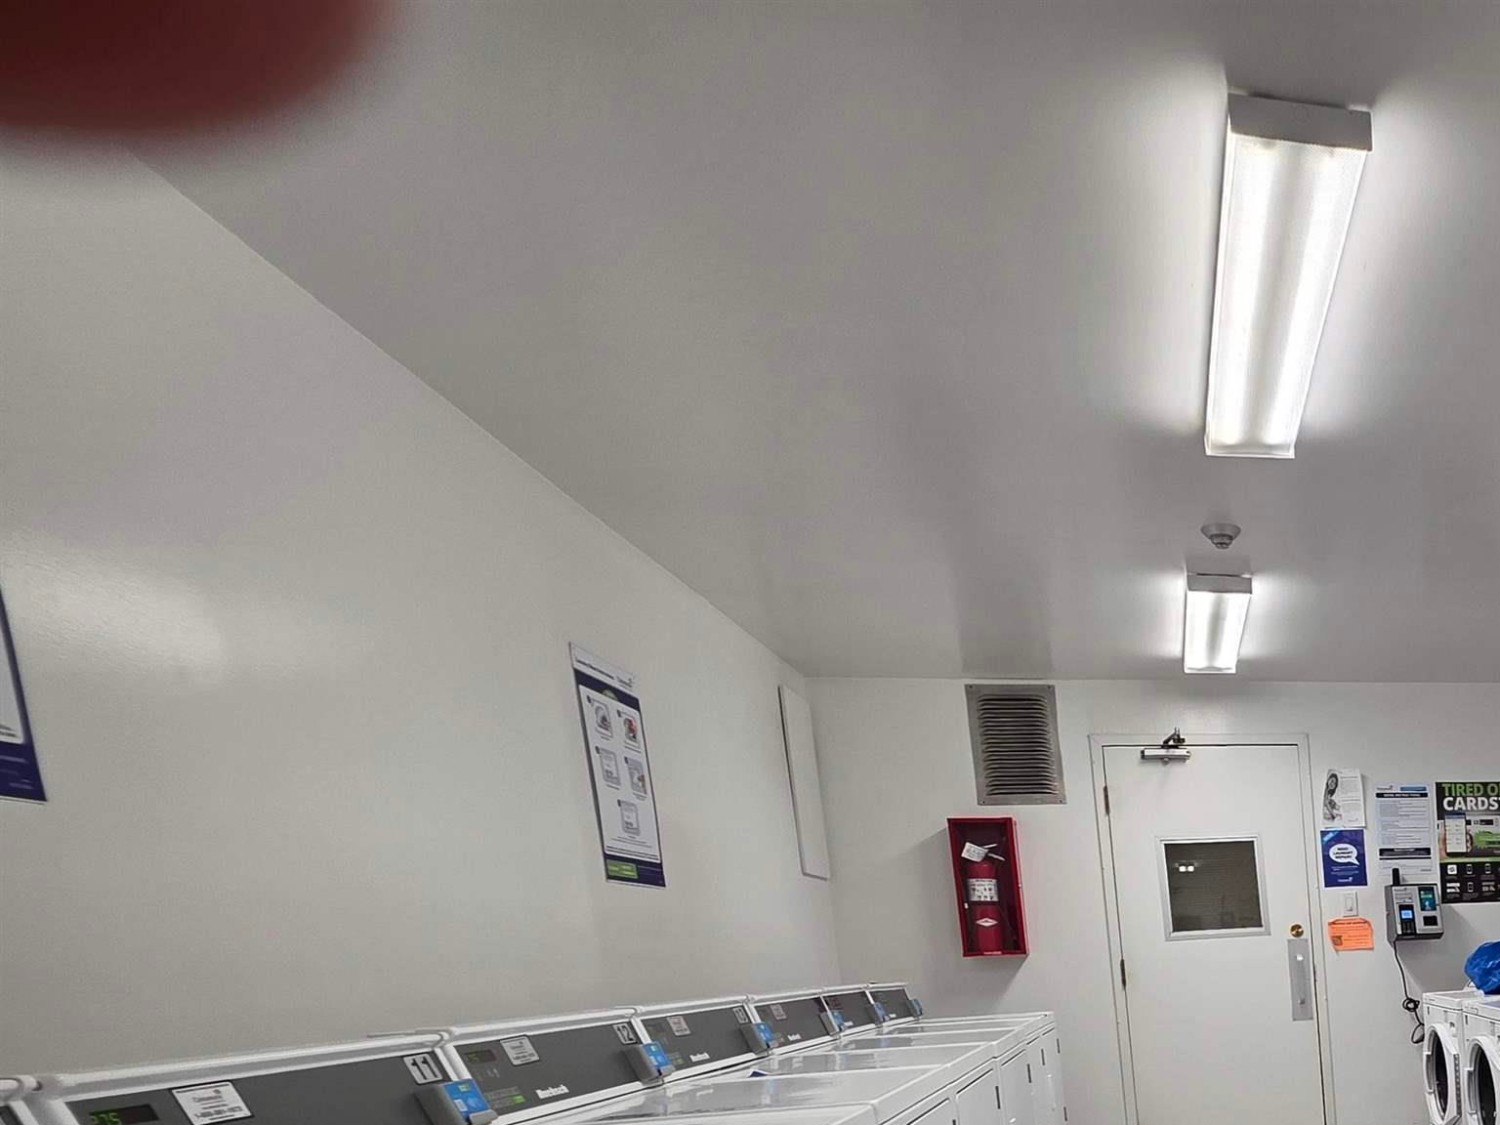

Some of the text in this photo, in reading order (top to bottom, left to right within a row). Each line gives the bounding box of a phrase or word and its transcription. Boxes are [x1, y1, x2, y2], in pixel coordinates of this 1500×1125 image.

[1442, 783, 1483, 796] TIRED
[616, 1024, 634, 1043] 12
[410, 1056, 438, 1080] 11
